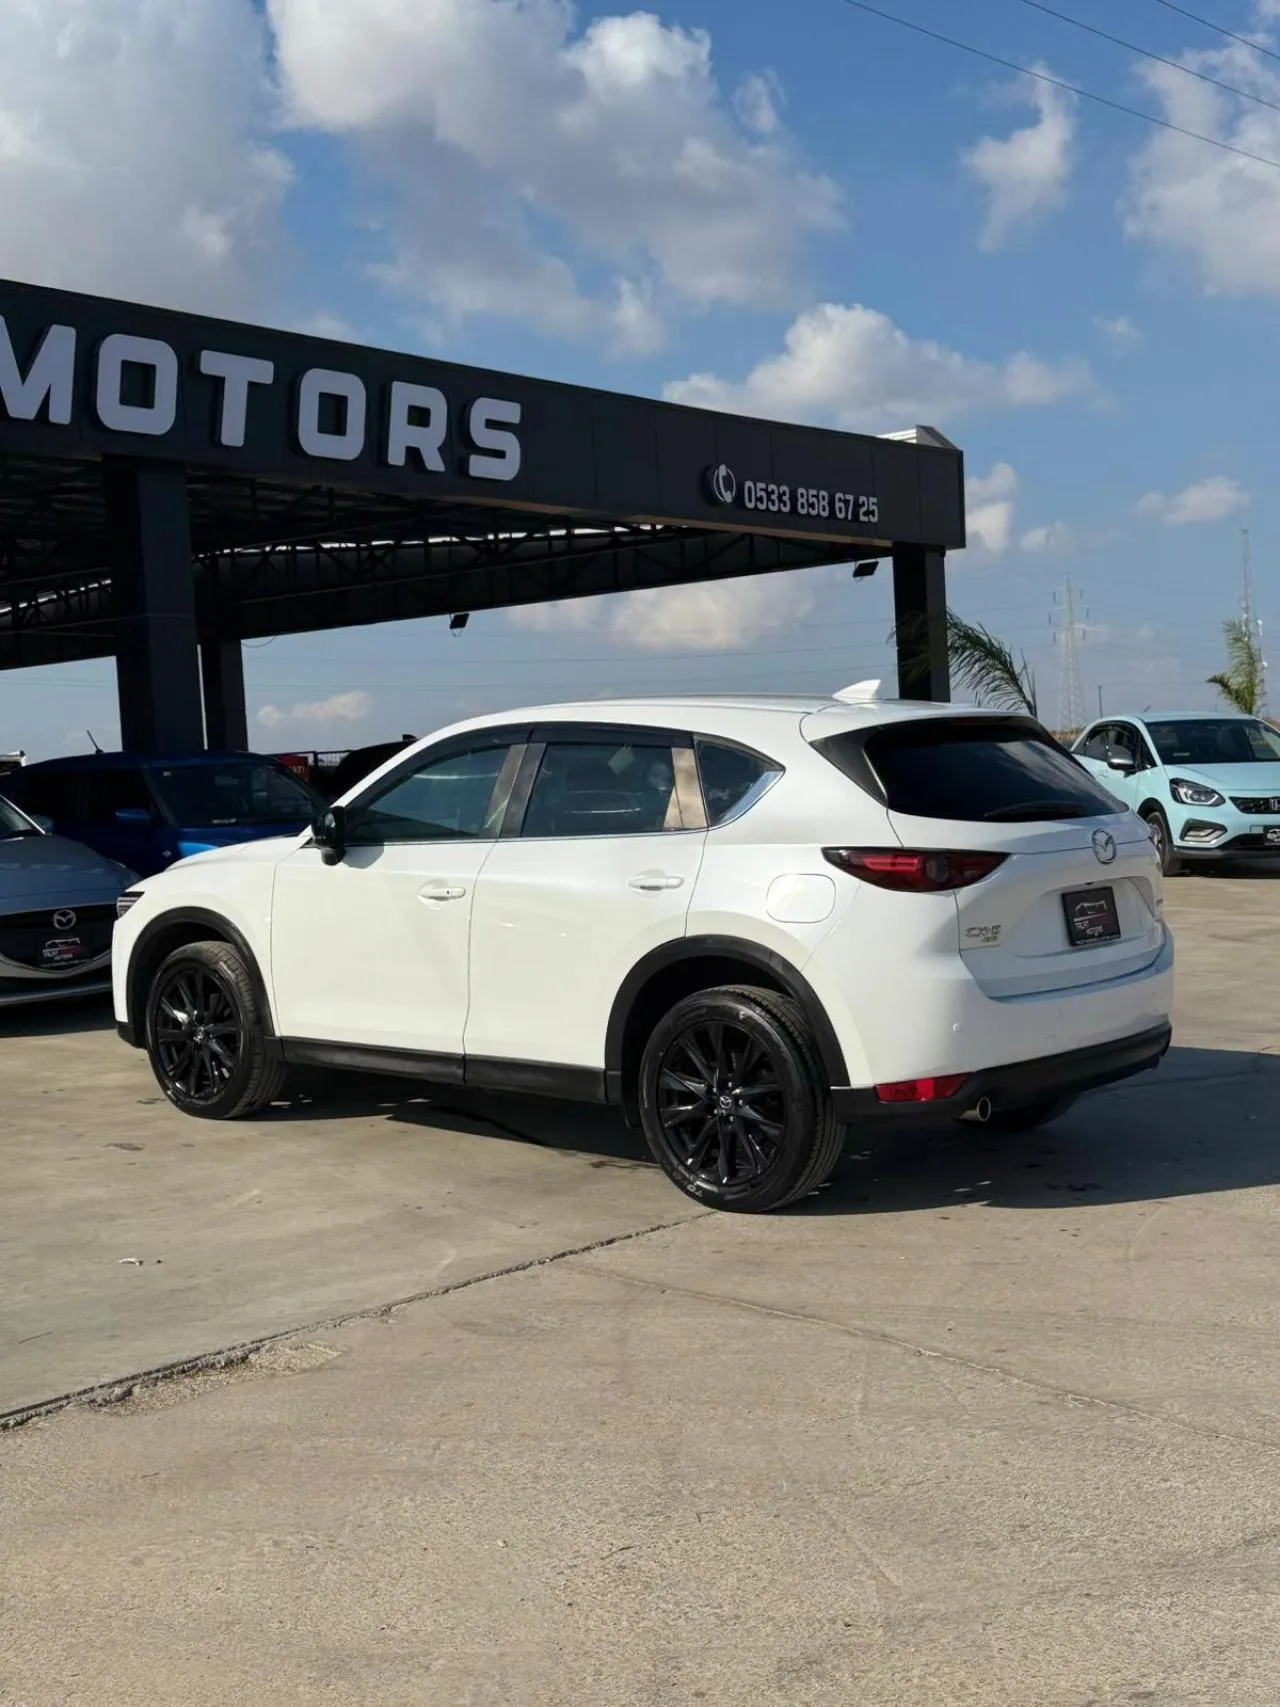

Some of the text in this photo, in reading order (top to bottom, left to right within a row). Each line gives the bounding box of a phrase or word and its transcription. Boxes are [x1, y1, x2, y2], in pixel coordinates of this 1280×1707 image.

[0, 313, 521, 481] MOTORS
[744, 480, 878, 522] 0533 858 67 25
